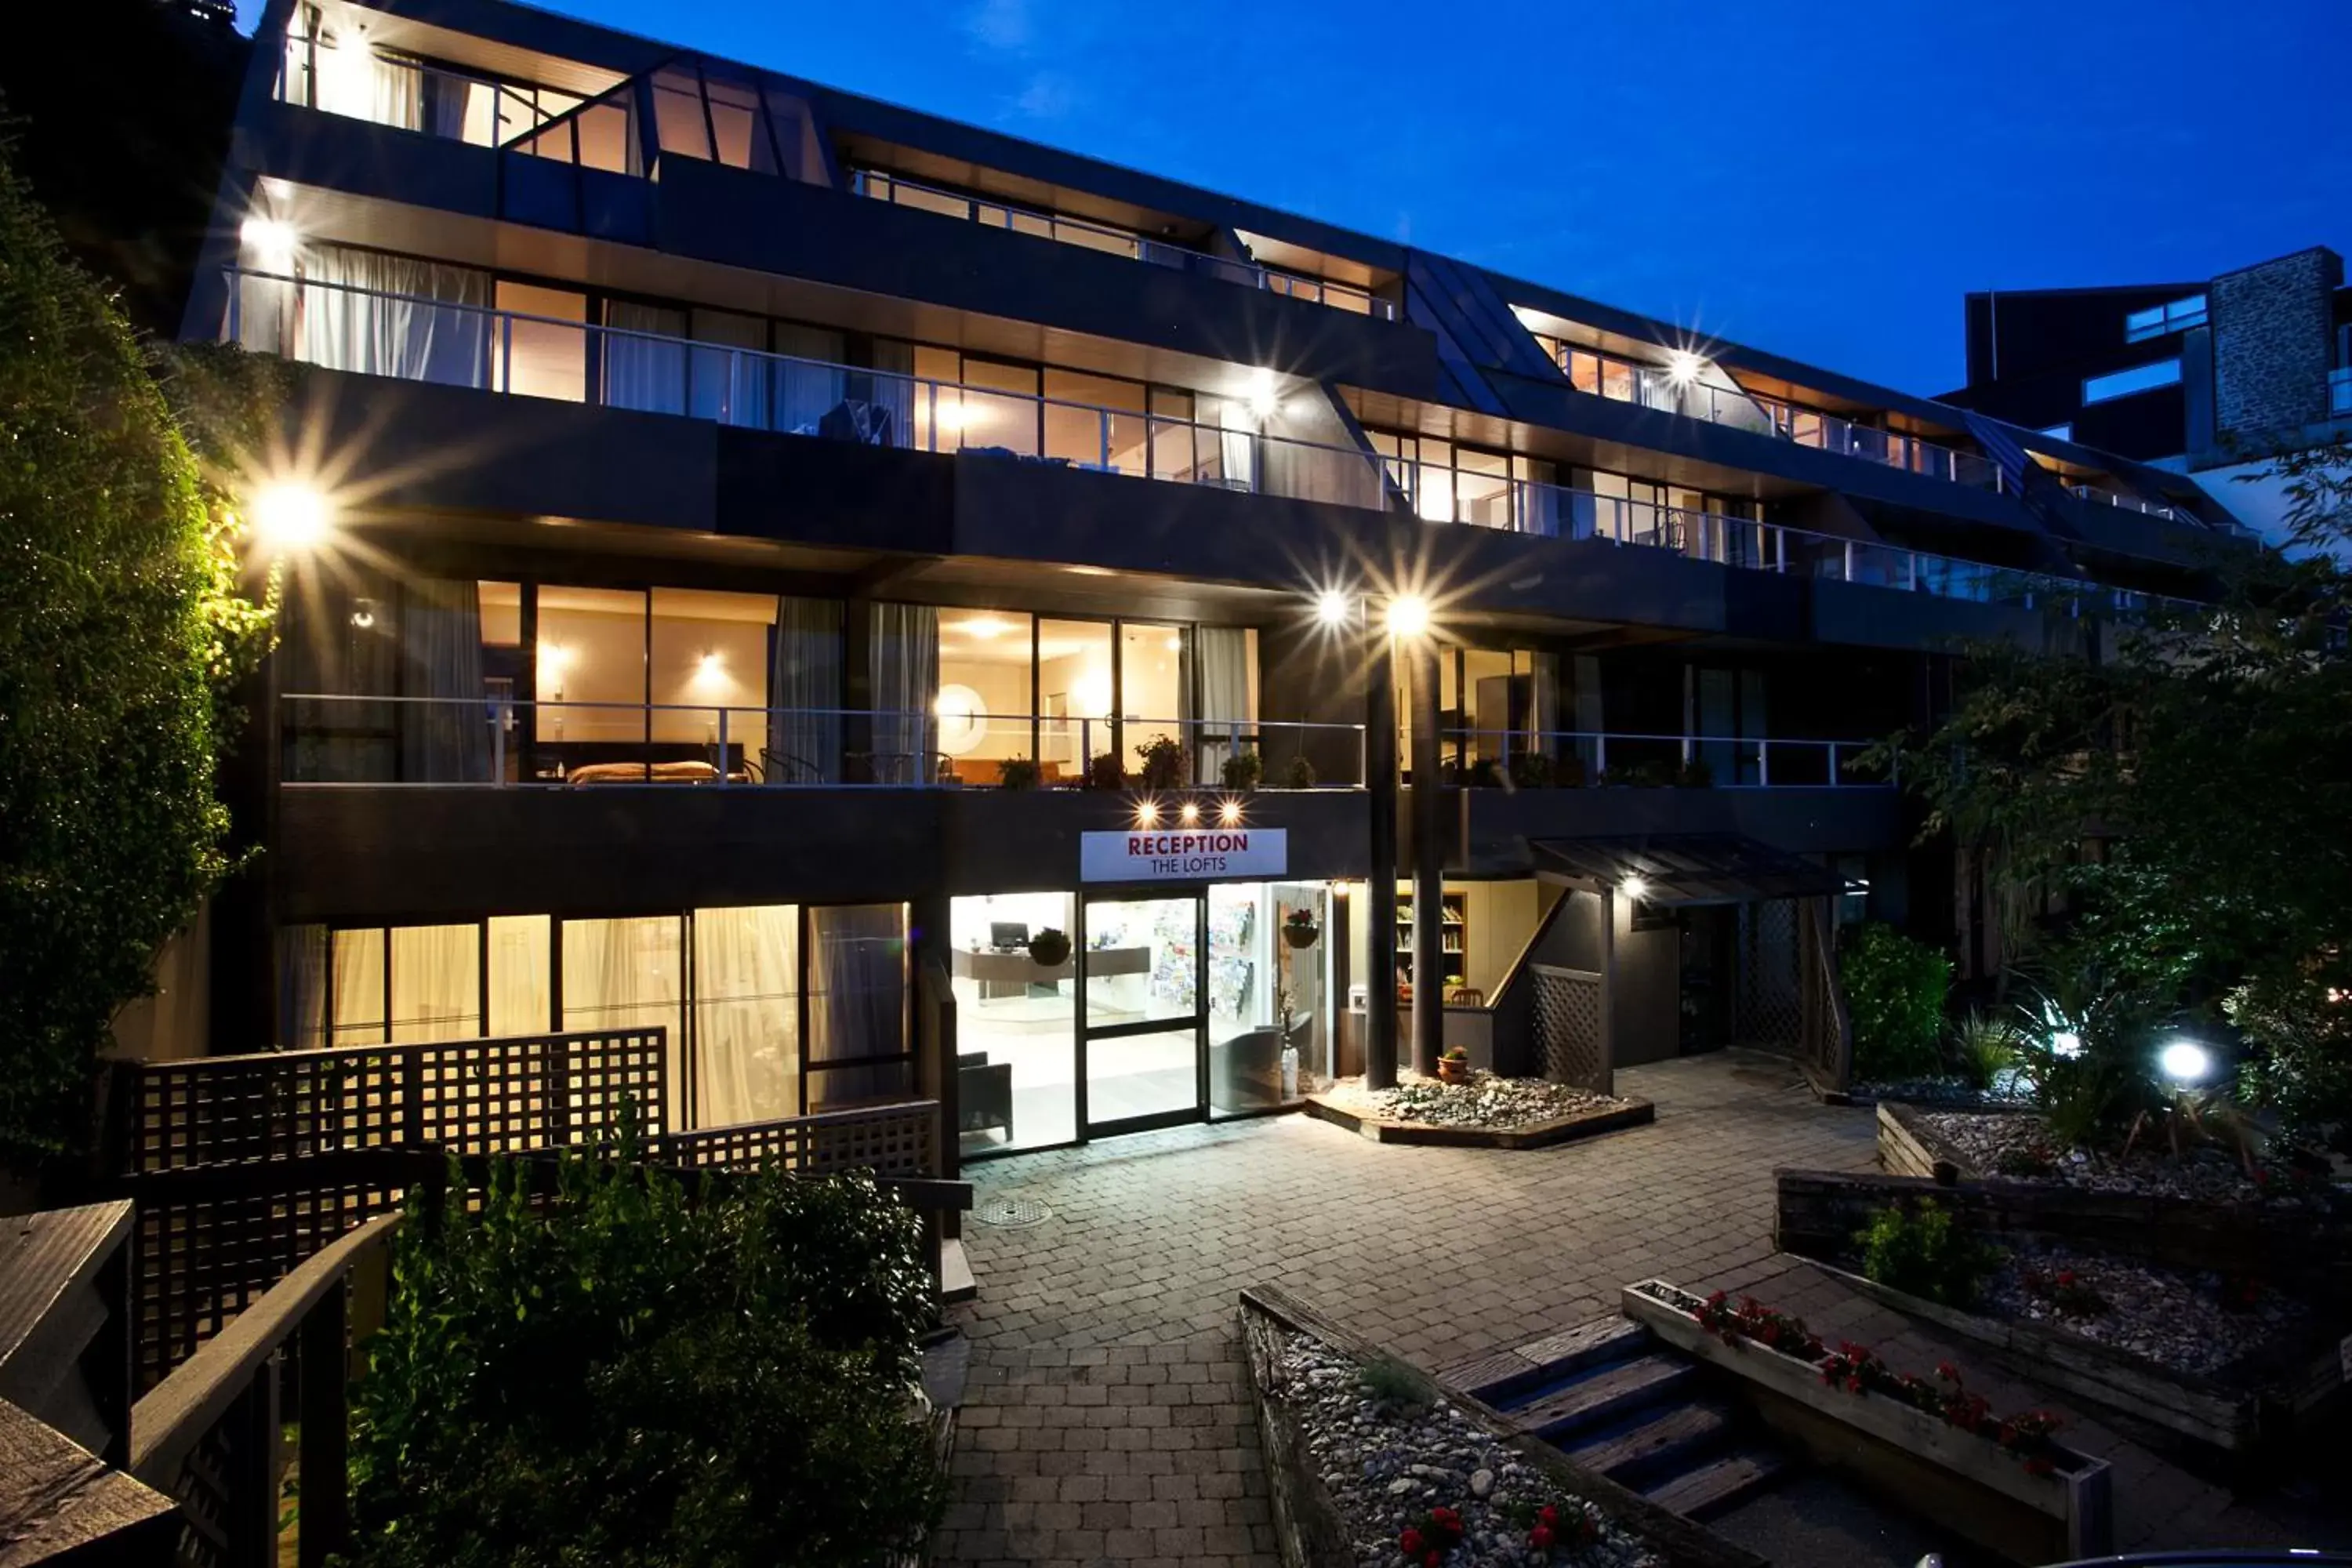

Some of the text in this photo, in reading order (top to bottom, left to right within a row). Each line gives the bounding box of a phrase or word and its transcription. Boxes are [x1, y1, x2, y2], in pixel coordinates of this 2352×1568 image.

[1128, 834, 1248, 855] RECEPTION
[1152, 857, 1227, 873] THE LOFTS
